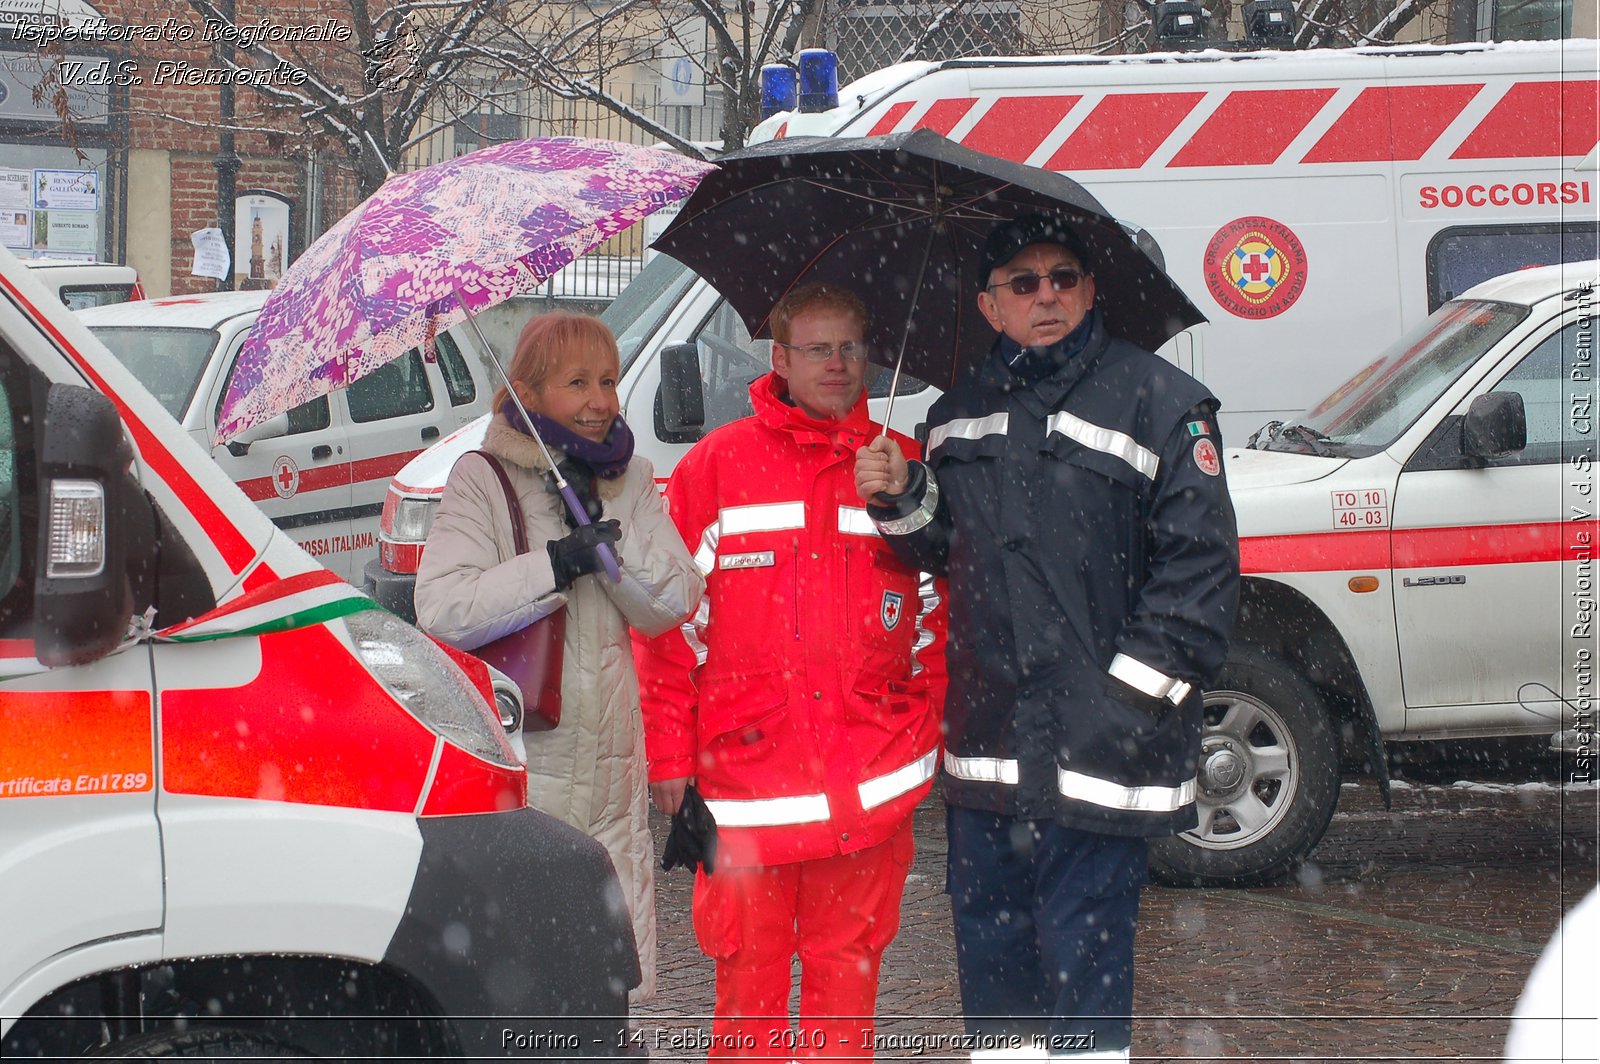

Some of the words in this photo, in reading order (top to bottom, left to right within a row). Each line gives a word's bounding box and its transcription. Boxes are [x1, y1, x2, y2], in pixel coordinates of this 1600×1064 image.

[1419, 181, 1591, 209] SOCCORSI
[1207, 230, 1230, 266] CROCE
[1230, 219, 1267, 233] ROSSA
[1269, 222, 1304, 265] ITALIANA
[1208, 272, 1267, 317] SALVATAGGIO
[1269, 304, 1281, 315] IN
[1283, 271, 1305, 306] ACQUA
[1336, 492, 1357, 507] TO
[1364, 491, 1380, 506] 10
[1340, 510, 1382, 526] 40-03
[331, 532, 374, 553] ITALIANA
[1403, 574, 1467, 588] L200
[75, 772, 148, 792] En1789
